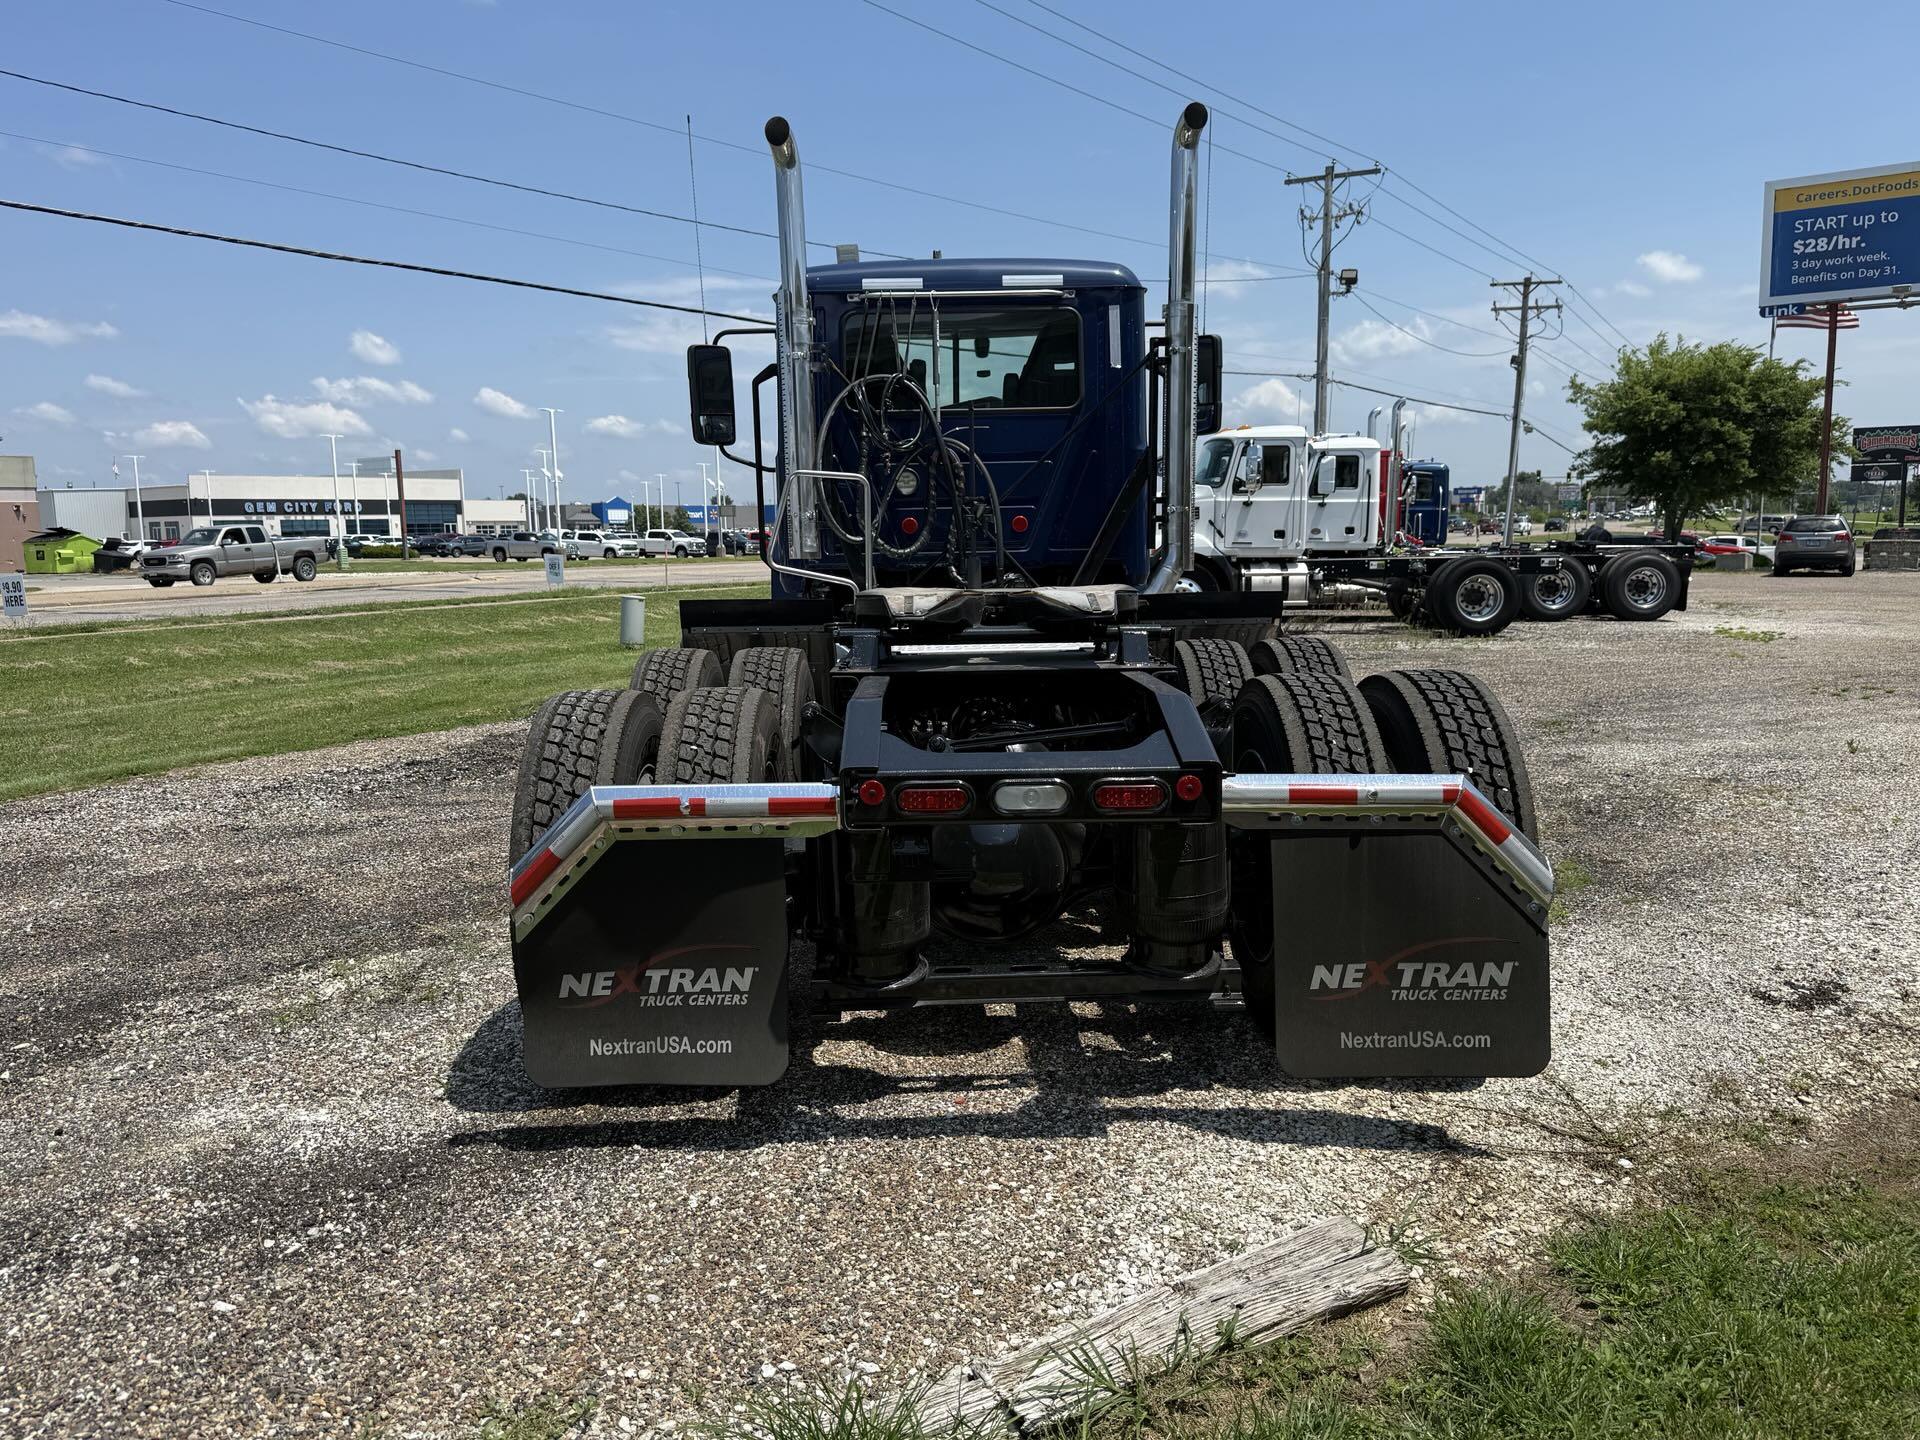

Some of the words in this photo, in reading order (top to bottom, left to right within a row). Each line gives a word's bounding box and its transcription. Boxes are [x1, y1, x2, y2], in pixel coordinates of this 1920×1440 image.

[1794, 215, 1848, 233] START
[1853, 214, 1875, 229] up
[1881, 211, 1899, 223] to
[1793, 235, 1866, 255] $28/hr.
[1792, 261, 1799, 270] 3
[1801, 259, 1822, 270] day
[1825, 254, 1854, 266] work
[1857, 251, 1890, 263] week.
[1791, 271, 1837, 284] Benefits
[1840, 271, 1855, 280] on
[1858, 267, 1881, 279] Day
[1883, 265, 1901, 275] 31.
[1765, 304, 1798, 317] Link
[244, 501, 277, 513] GEM
[284, 501, 318, 513] CITY
[2, 581, 22, 593] $9.90
[5, 595, 25, 607] HERE
[559, 964, 755, 998] NEXTRAN
[1310, 961, 1514, 990] NEXTRAN
[640, 994, 683, 1007] TRUCK
[689, 994, 749, 1006] CENTERS
[1391, 989, 1437, 1001] TRUCK
[1443, 989, 1508, 1001] CENTERS
[590, 1036, 732, 1056] NextranUSA.com
[1340, 1031, 1491, 1049] NextranUSA.com
